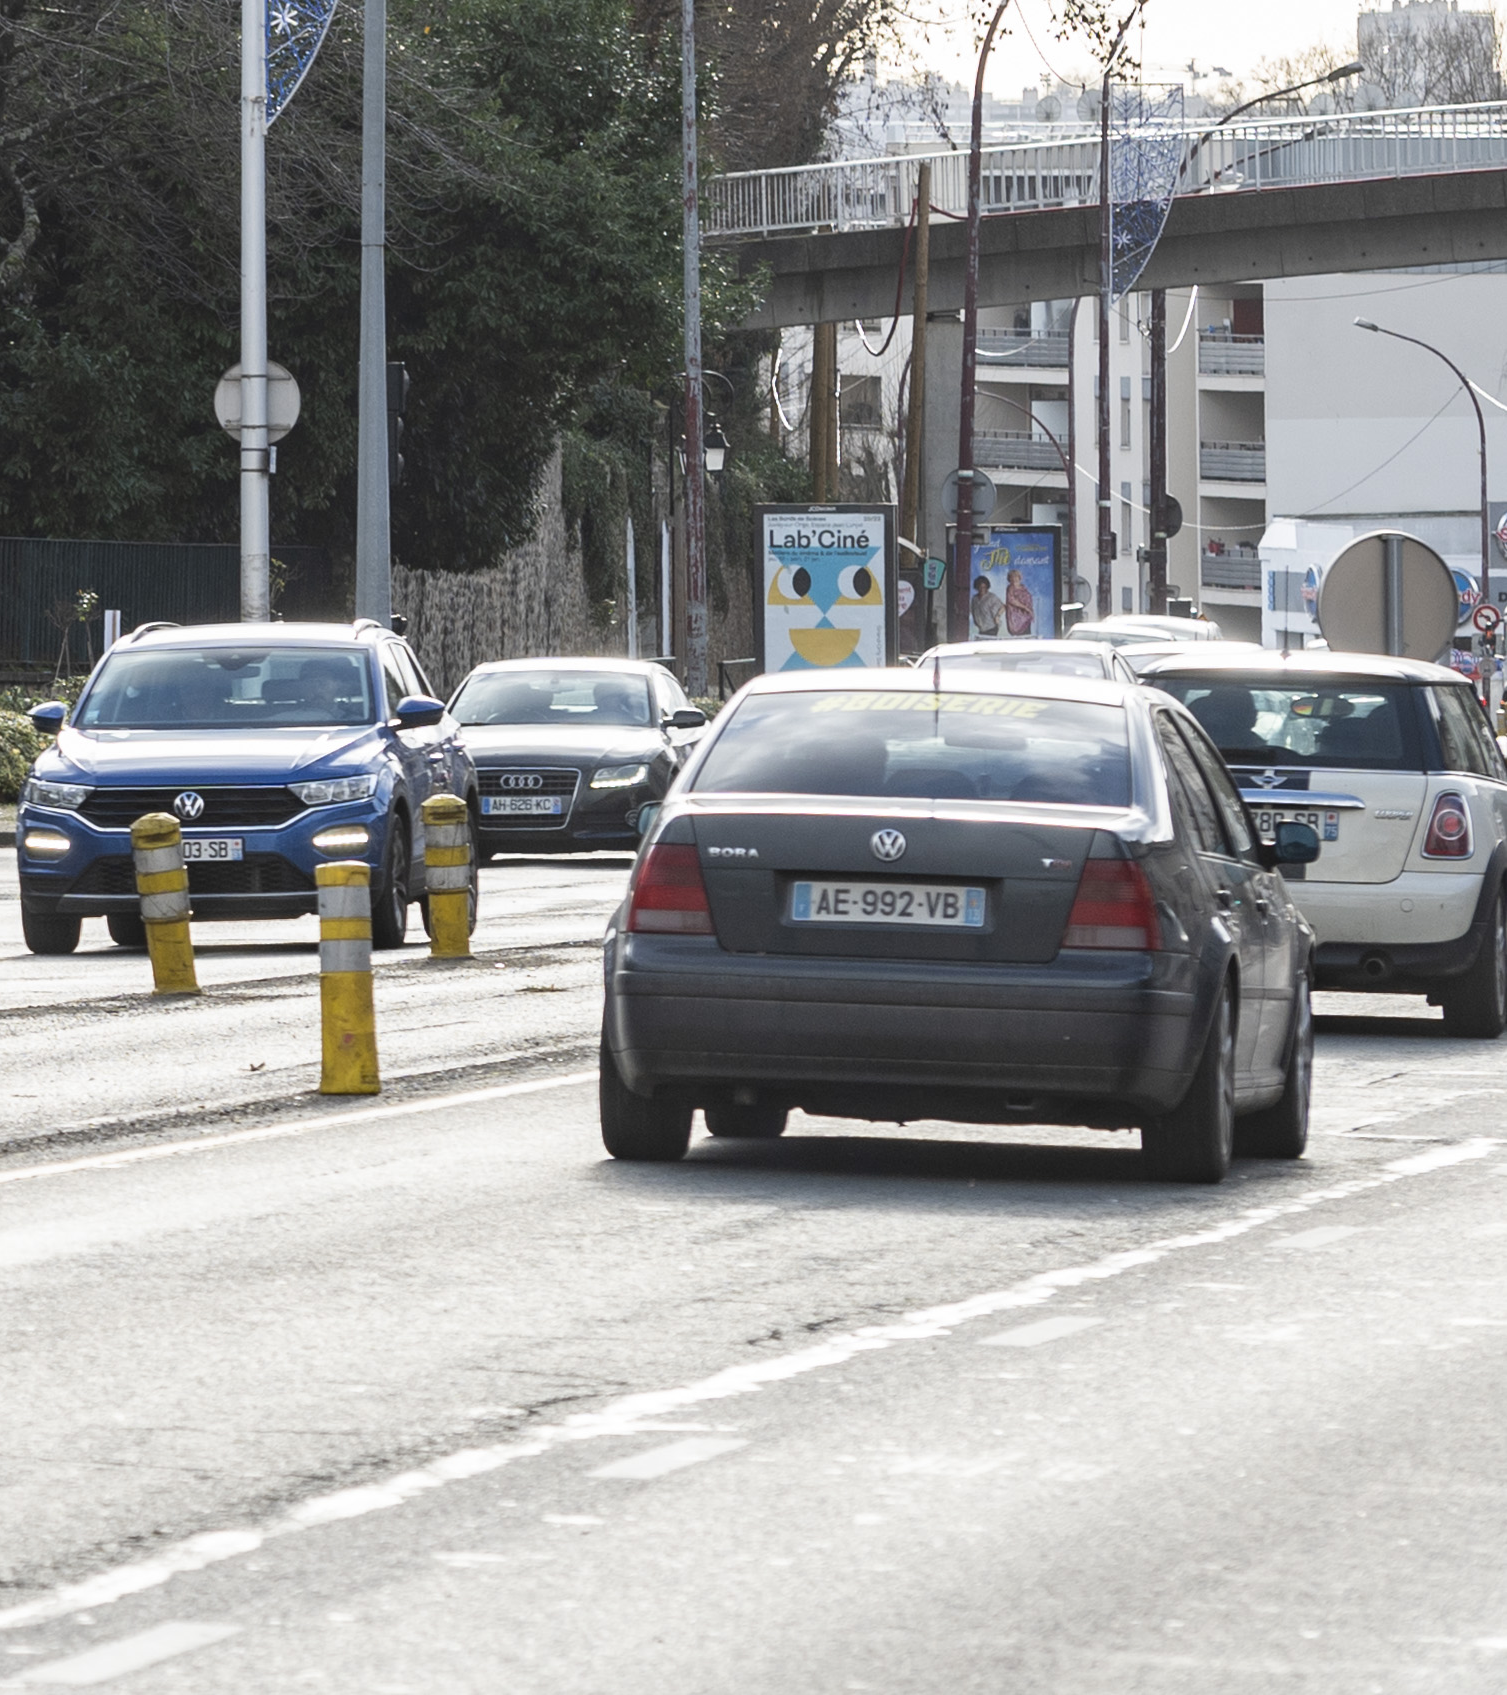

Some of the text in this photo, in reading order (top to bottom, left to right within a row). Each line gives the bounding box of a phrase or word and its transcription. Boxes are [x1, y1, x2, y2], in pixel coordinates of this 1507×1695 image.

[769, 529, 870, 549] Lab'Ciné
[707, 846, 759, 859] BORA
[815, 888, 960, 919] AE-992-VB
